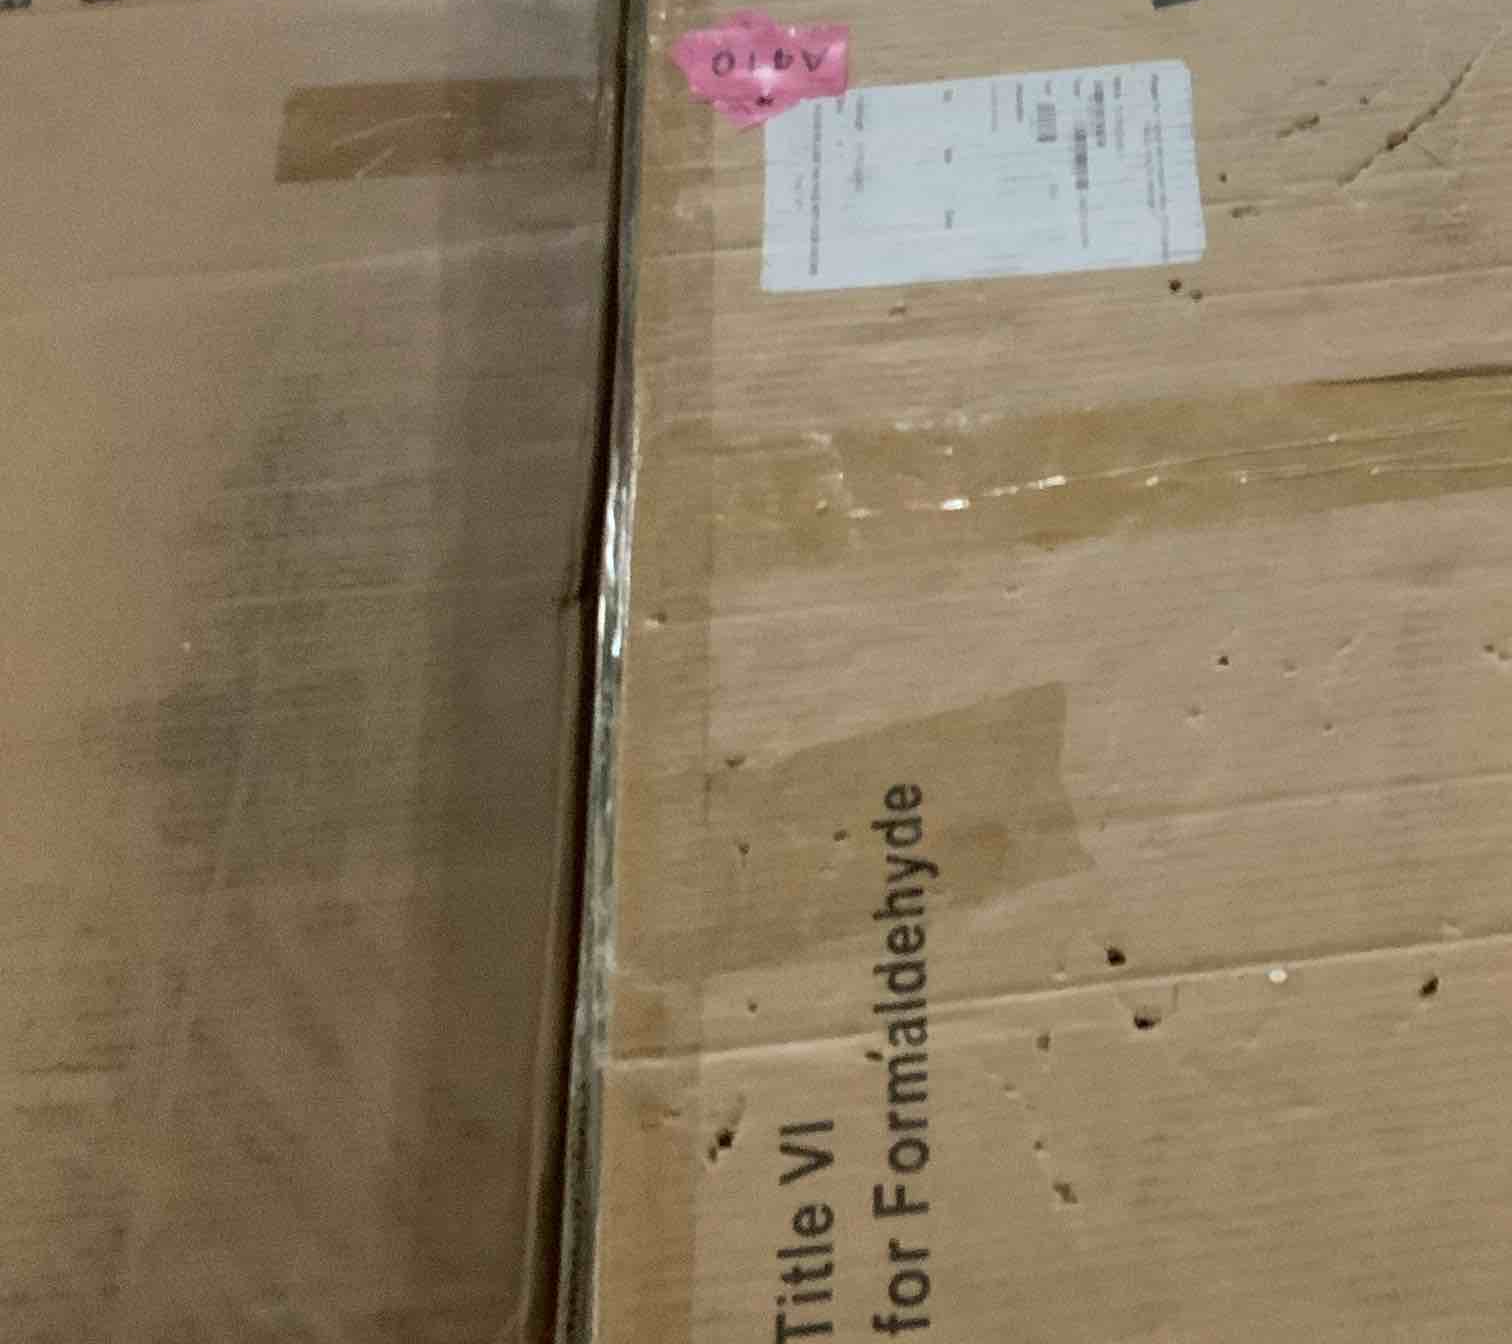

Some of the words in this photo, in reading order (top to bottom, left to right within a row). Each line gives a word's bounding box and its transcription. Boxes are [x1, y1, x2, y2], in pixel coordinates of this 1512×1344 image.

[871, 782, 940, 1220] Formaldehyde
[778, 1119, 835, 1186] VI
[872, 1238, 931, 1336] for
